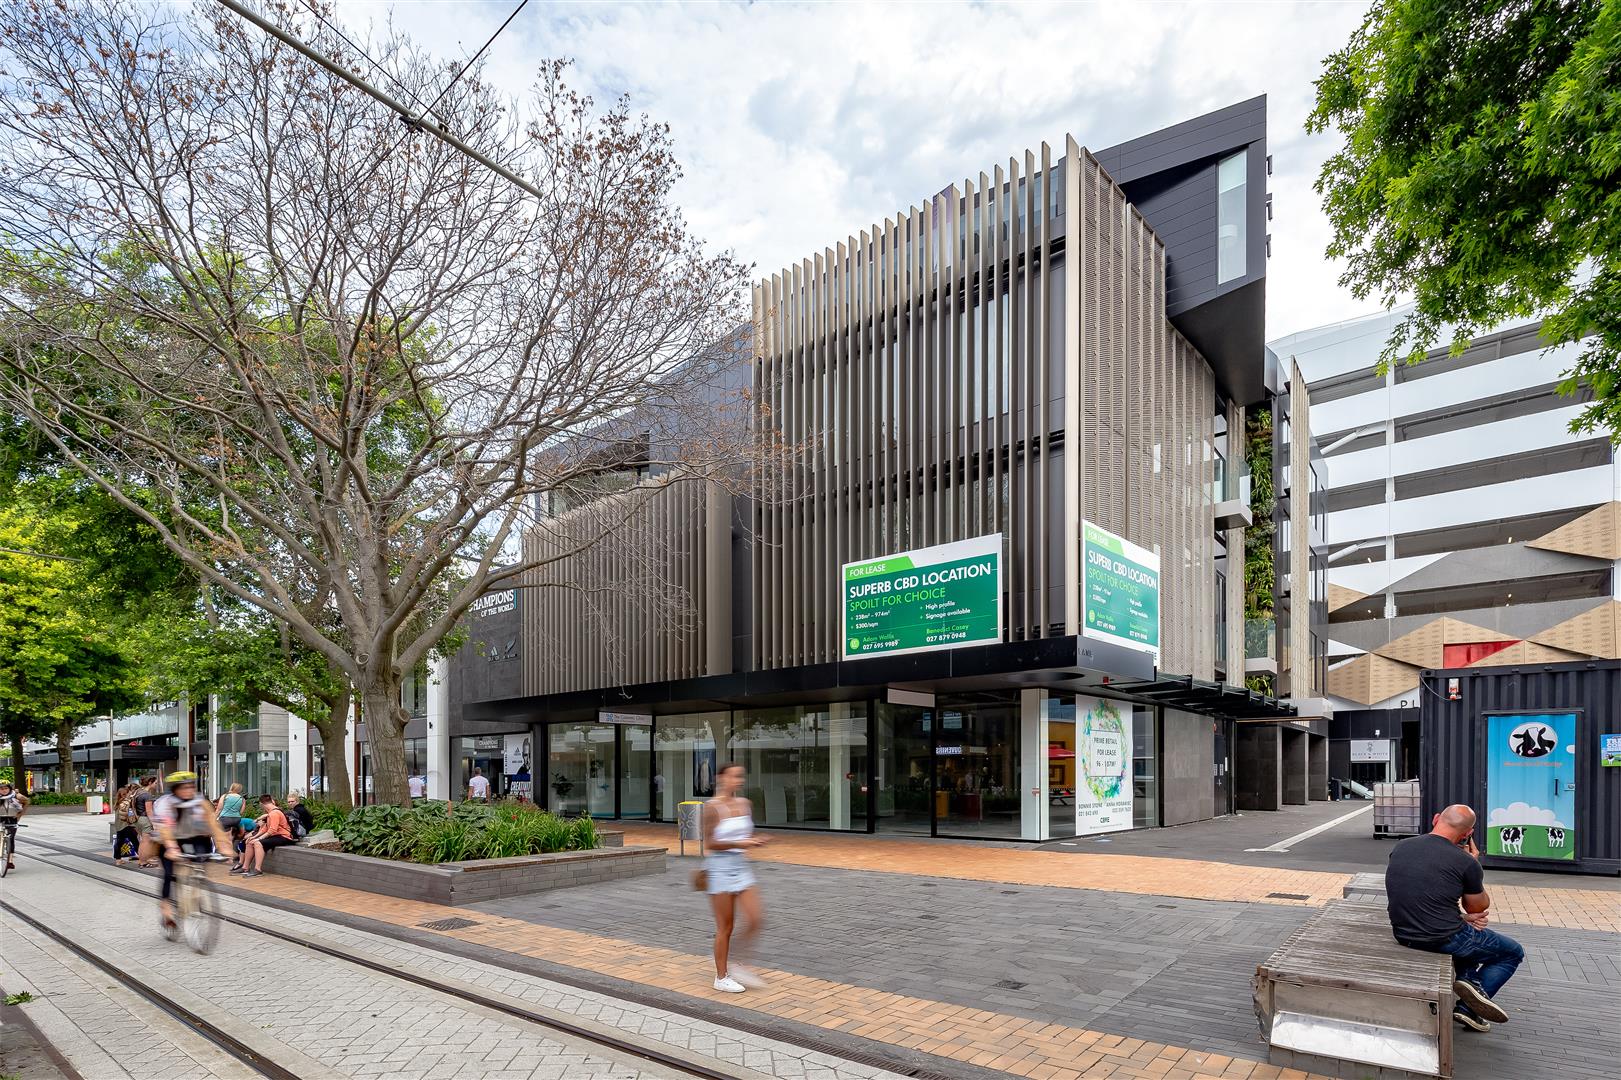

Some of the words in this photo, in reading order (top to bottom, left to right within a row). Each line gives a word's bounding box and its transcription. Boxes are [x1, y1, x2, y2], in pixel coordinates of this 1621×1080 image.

[850, 567, 864, 576] FOR
[866, 564, 886, 575] LEASE
[1088, 550, 1112, 571] SUPERB
[1113, 561, 1127, 577] CBD
[1128, 566, 1157, 590] LOCATION
[850, 581, 892, 599] SUPERB
[894, 575, 919, 591] CBD
[922, 562, 991, 586] LOCATION
[850, 597, 880, 612] SPOILT
[882, 594, 902, 606] FOR
[904, 587, 946, 603] CHOICE
[925, 602, 938, 611] High
[938, 601, 956, 610] profile
[925, 611, 946, 620] Signage
[947, 608, 971, 617] available
